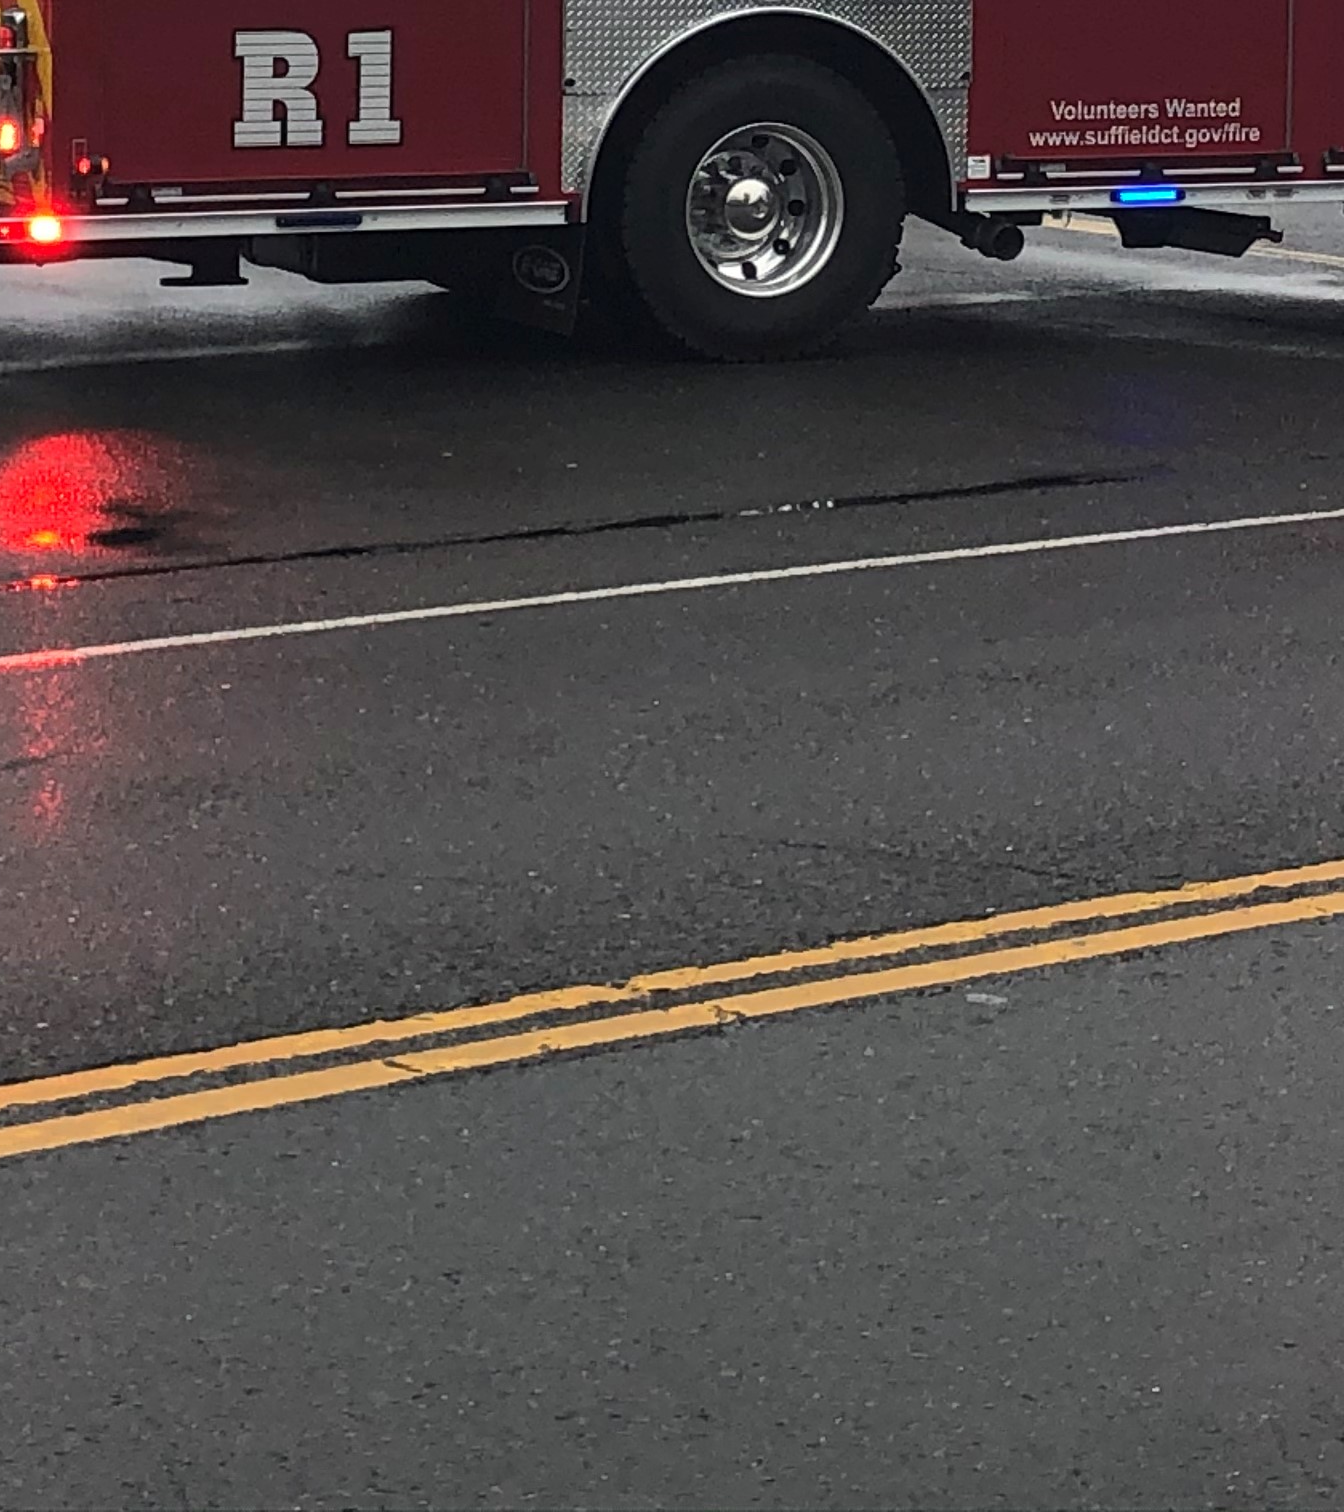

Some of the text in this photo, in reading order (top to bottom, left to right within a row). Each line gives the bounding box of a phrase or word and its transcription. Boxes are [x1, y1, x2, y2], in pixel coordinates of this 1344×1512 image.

[232, 28, 403, 149] R1
[1049, 96, 1242, 121] Volunteers Wanted
[1028, 122, 1261, 149] www.suffieldct.gov/fire
